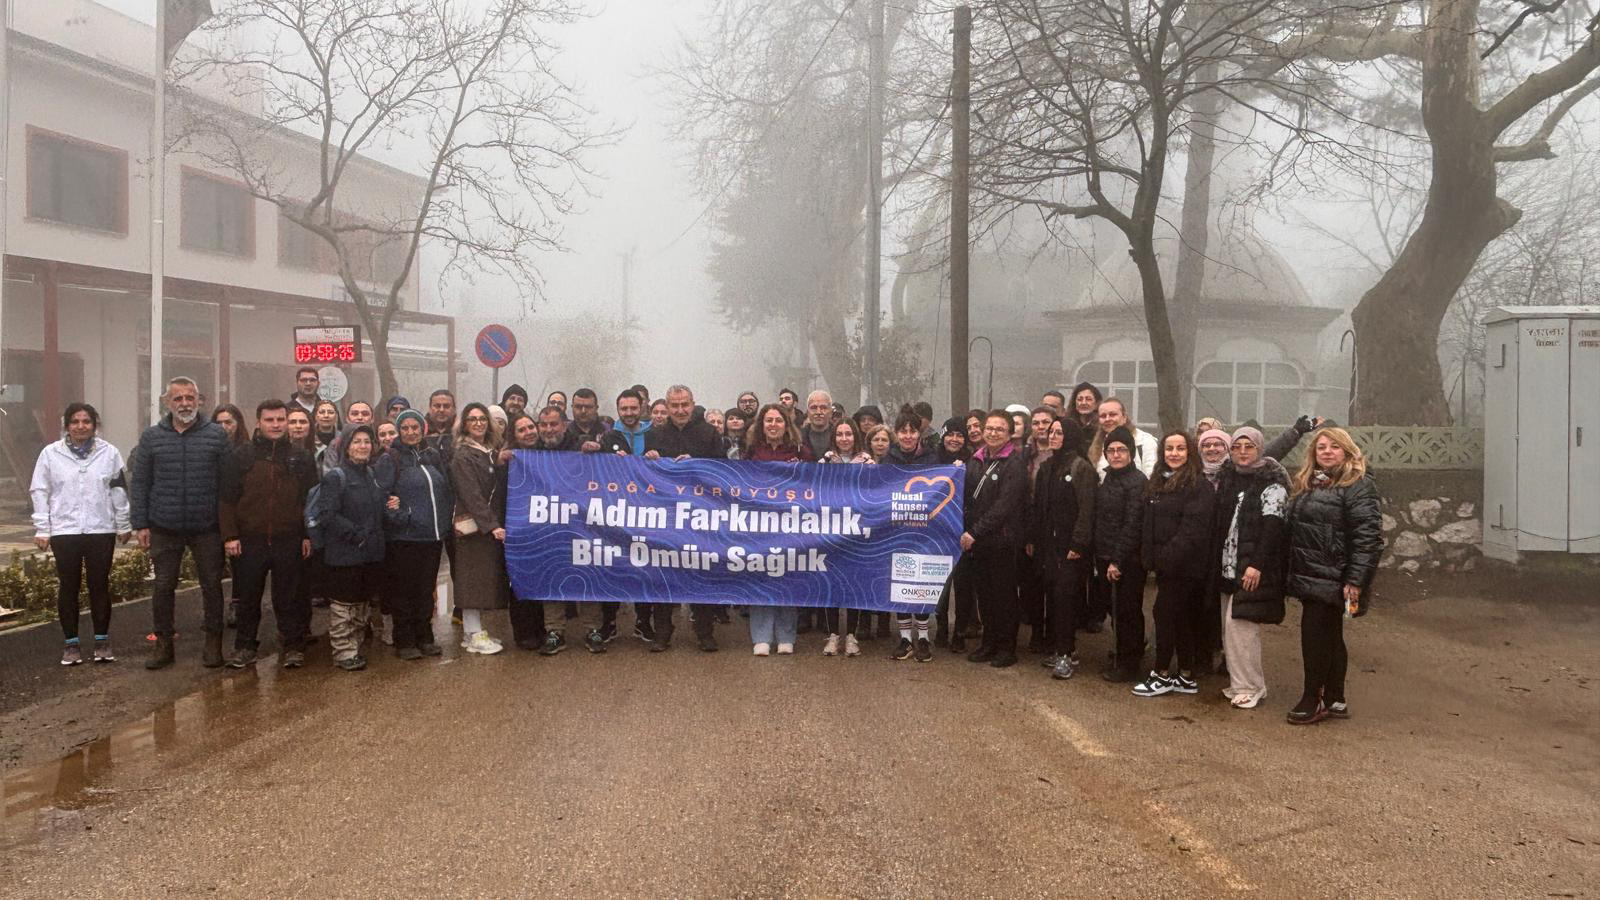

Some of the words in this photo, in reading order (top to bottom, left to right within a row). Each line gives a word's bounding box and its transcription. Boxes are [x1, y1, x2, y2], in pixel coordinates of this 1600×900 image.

[587, 480, 657, 493] DOĞA
[676, 485, 815, 502] YÜRÜYÜŞÜ
[891, 492, 923, 501] Ulusal
[891, 502, 928, 511] Kanser
[529, 495, 579, 524] Bir
[586, 497, 667, 529] Adım
[675, 503, 871, 539] Farkındalık,
[891, 512, 928, 521] Haftası
[572, 538, 622, 567] Bir
[629, 536, 720, 571] Ömür
[726, 546, 828, 577] Sağlık
